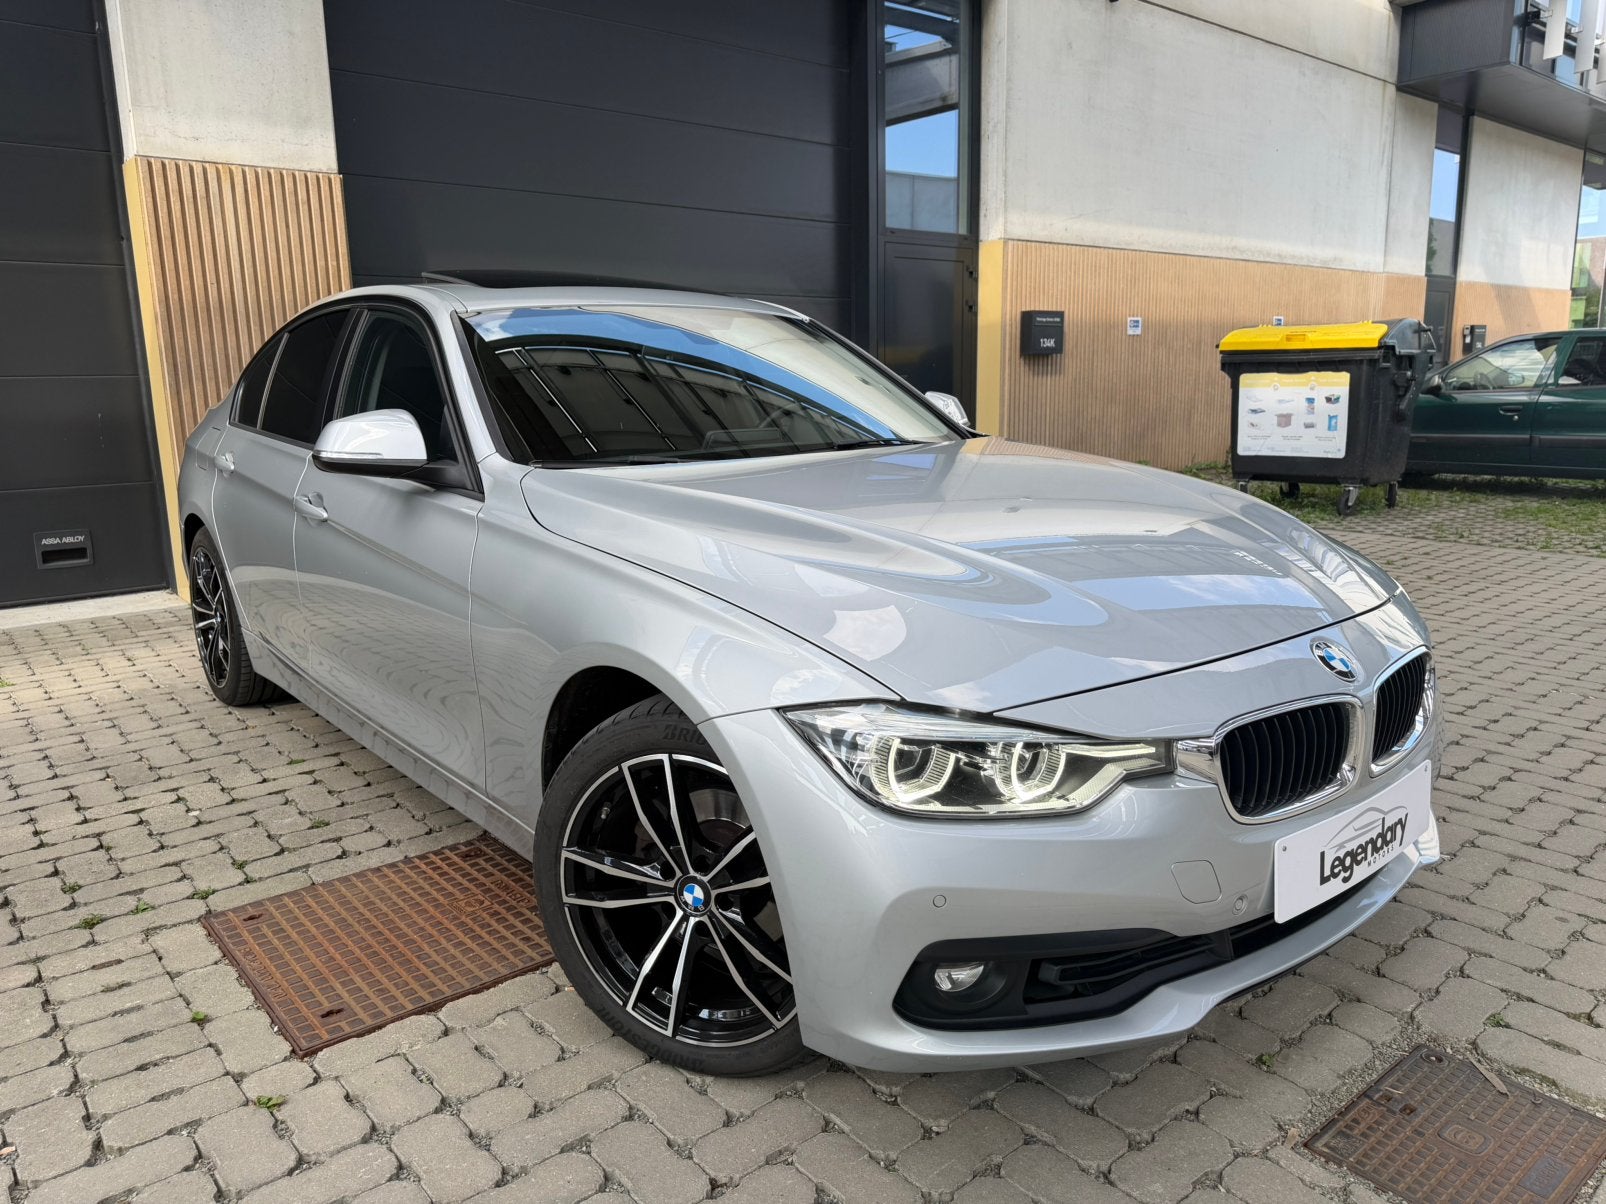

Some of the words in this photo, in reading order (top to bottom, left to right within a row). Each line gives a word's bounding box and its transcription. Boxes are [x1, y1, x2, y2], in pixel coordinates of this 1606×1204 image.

[1040, 338, 1056, 348] 134K
[41, 537, 61, 545] ASSA
[61, 535, 85, 543] ABLOY
[1319, 812, 1408, 886] Legendary
[1367, 843, 1394, 868] MOTORS
